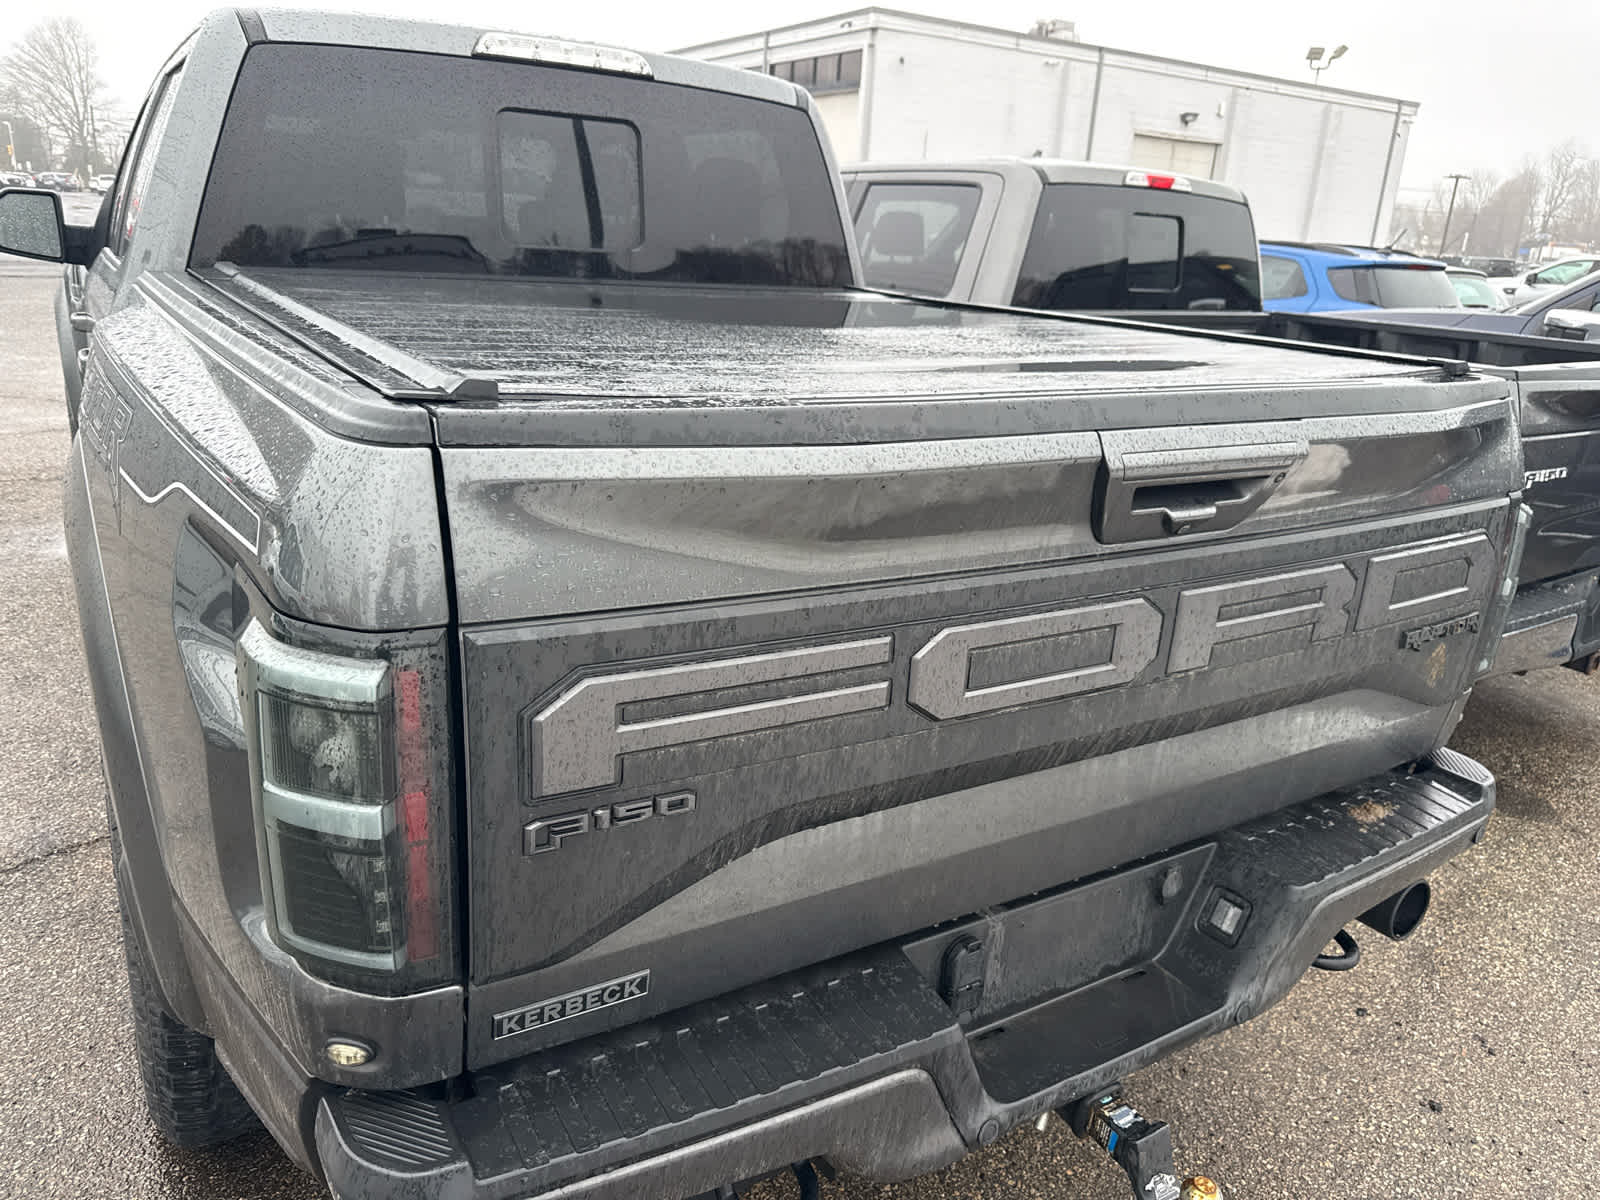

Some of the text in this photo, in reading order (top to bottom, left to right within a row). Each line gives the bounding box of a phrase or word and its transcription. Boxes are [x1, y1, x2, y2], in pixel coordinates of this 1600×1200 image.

[531, 533, 1495, 799] FORD
[524, 791, 697, 856] F150
[502, 976, 643, 1034] KERBECK
